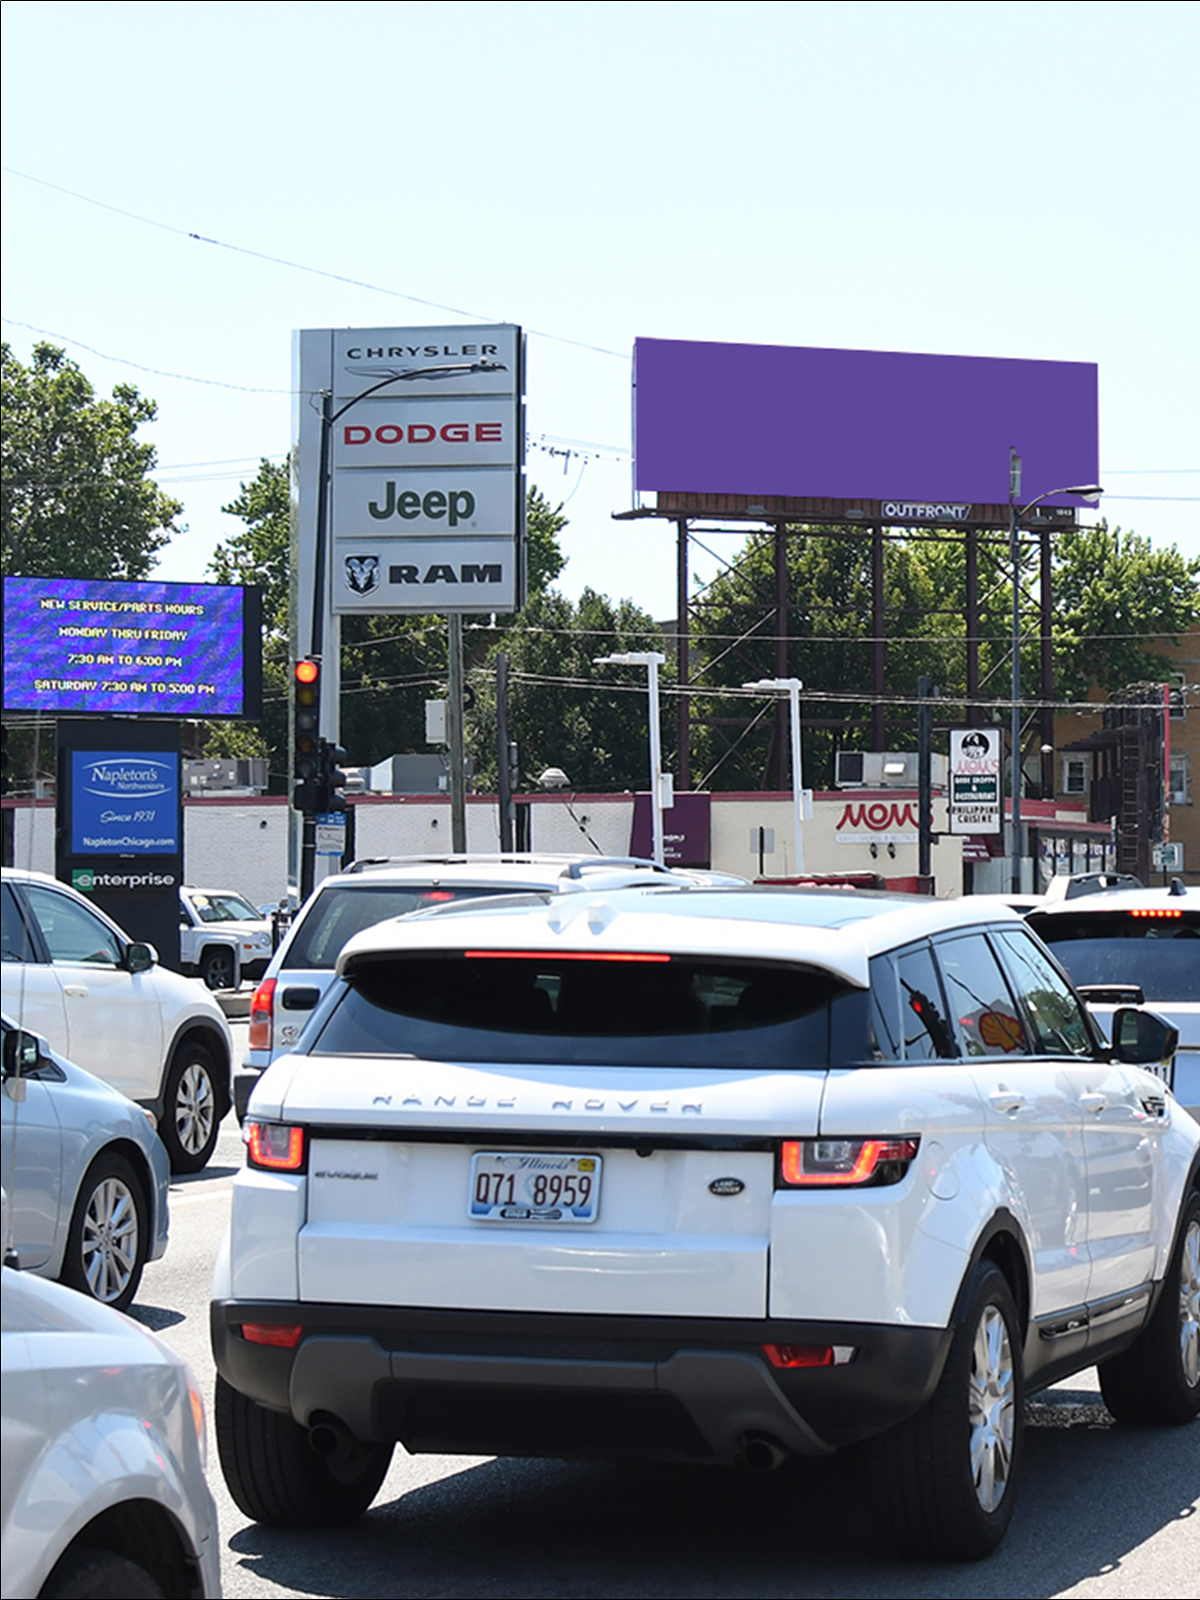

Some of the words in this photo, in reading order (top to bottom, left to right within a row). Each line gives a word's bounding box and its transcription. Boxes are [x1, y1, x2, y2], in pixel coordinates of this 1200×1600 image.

[346, 344, 498, 359] CHRYSLER
[344, 423, 502, 445] DODGE
[368, 481, 475, 527] Jeep
[885, 504, 966, 519] OUTFRONT
[389, 564, 502, 584] RAM
[40, 600, 65, 610] NEW
[68, 601, 163, 614] SERVICE/PARTS
[165, 604, 204, 615] HOURS
[59, 627, 108, 639] MONDAY
[111, 628, 142, 640] THRU
[144, 630, 188, 641] FRIDAY
[67, 654, 94, 665] 7:30
[97, 654, 114, 665] AM
[118, 655, 132, 665] TO
[135, 655, 162, 666] 6:00
[165, 657, 183, 667] PM
[34, 679, 98, 692] SATURDAY
[101, 681, 127, 692] 7:30
[130, 682, 147, 693] AM
[151, 683, 166, 693] TO
[168, 682, 195, 694] 5:00
[198, 684, 215, 694] PM
[91, 766, 158, 785] Napleton's
[100, 811, 132, 824] Since
[133, 811, 156, 823] 1931
[83, 837, 175, 848] NapletonChicago.com
[73, 872, 175, 888] enterprise
[372, 1095, 517, 1107] RANGE
[551, 1099, 703, 1115] ROVER
[518, 1157, 569, 1170] Illinois
[476, 1173, 516, 1206] Q71
[533, 1174, 592, 1208] 8959
